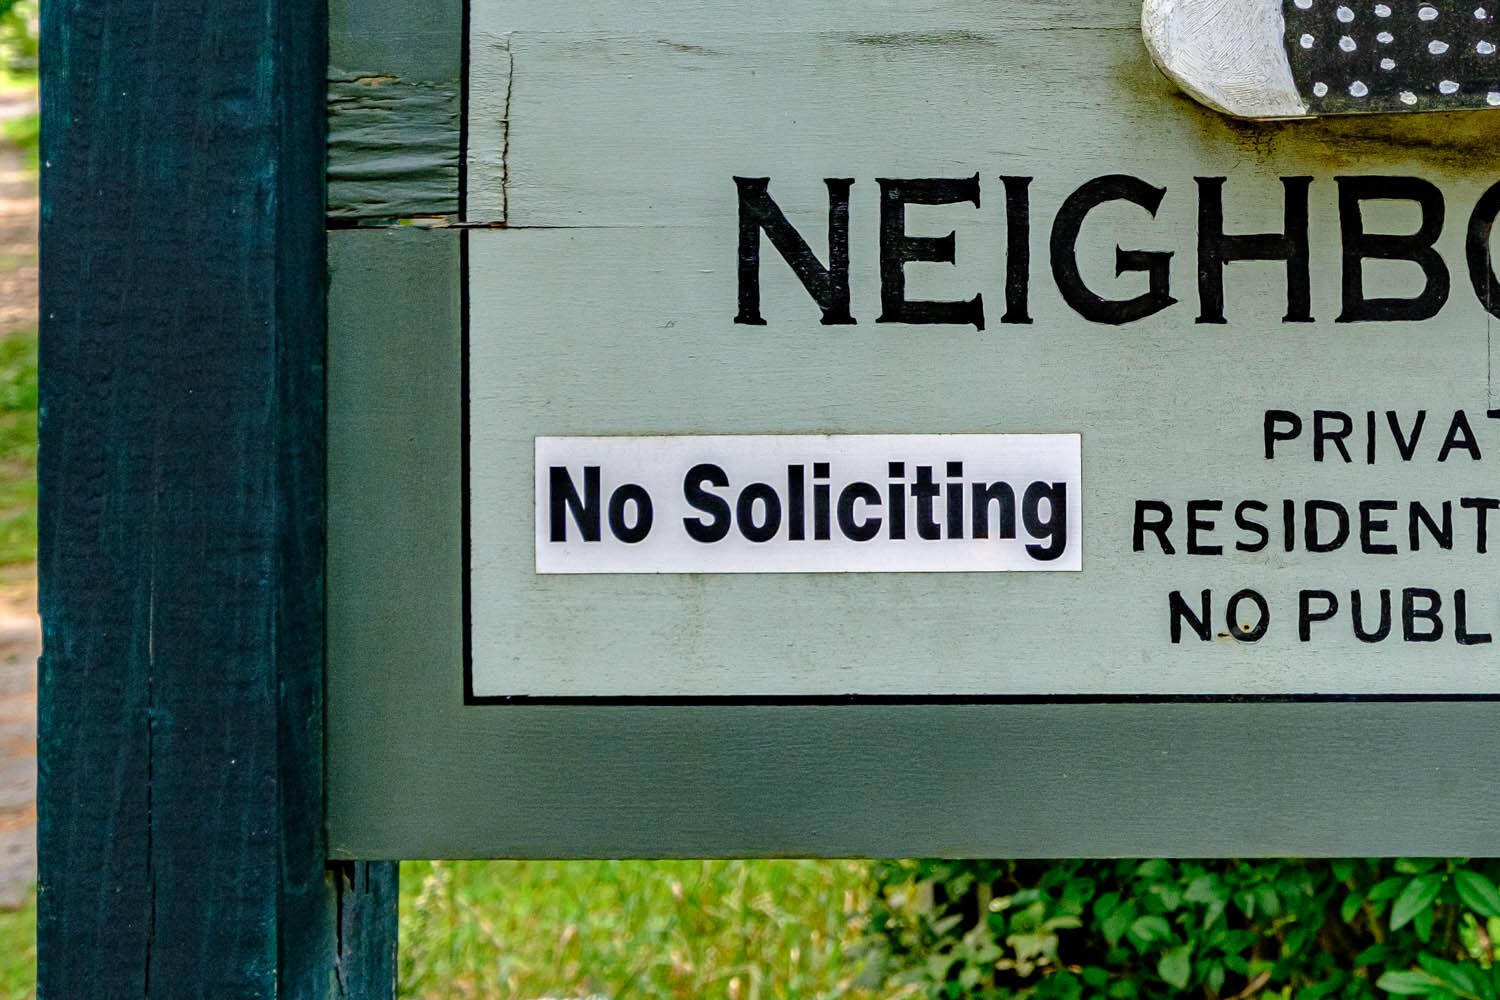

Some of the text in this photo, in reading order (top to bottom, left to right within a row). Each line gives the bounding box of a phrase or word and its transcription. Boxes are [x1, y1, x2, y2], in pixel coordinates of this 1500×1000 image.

[549, 461, 1067, 561] No Soliciting
[1168, 588, 1271, 644] NO
